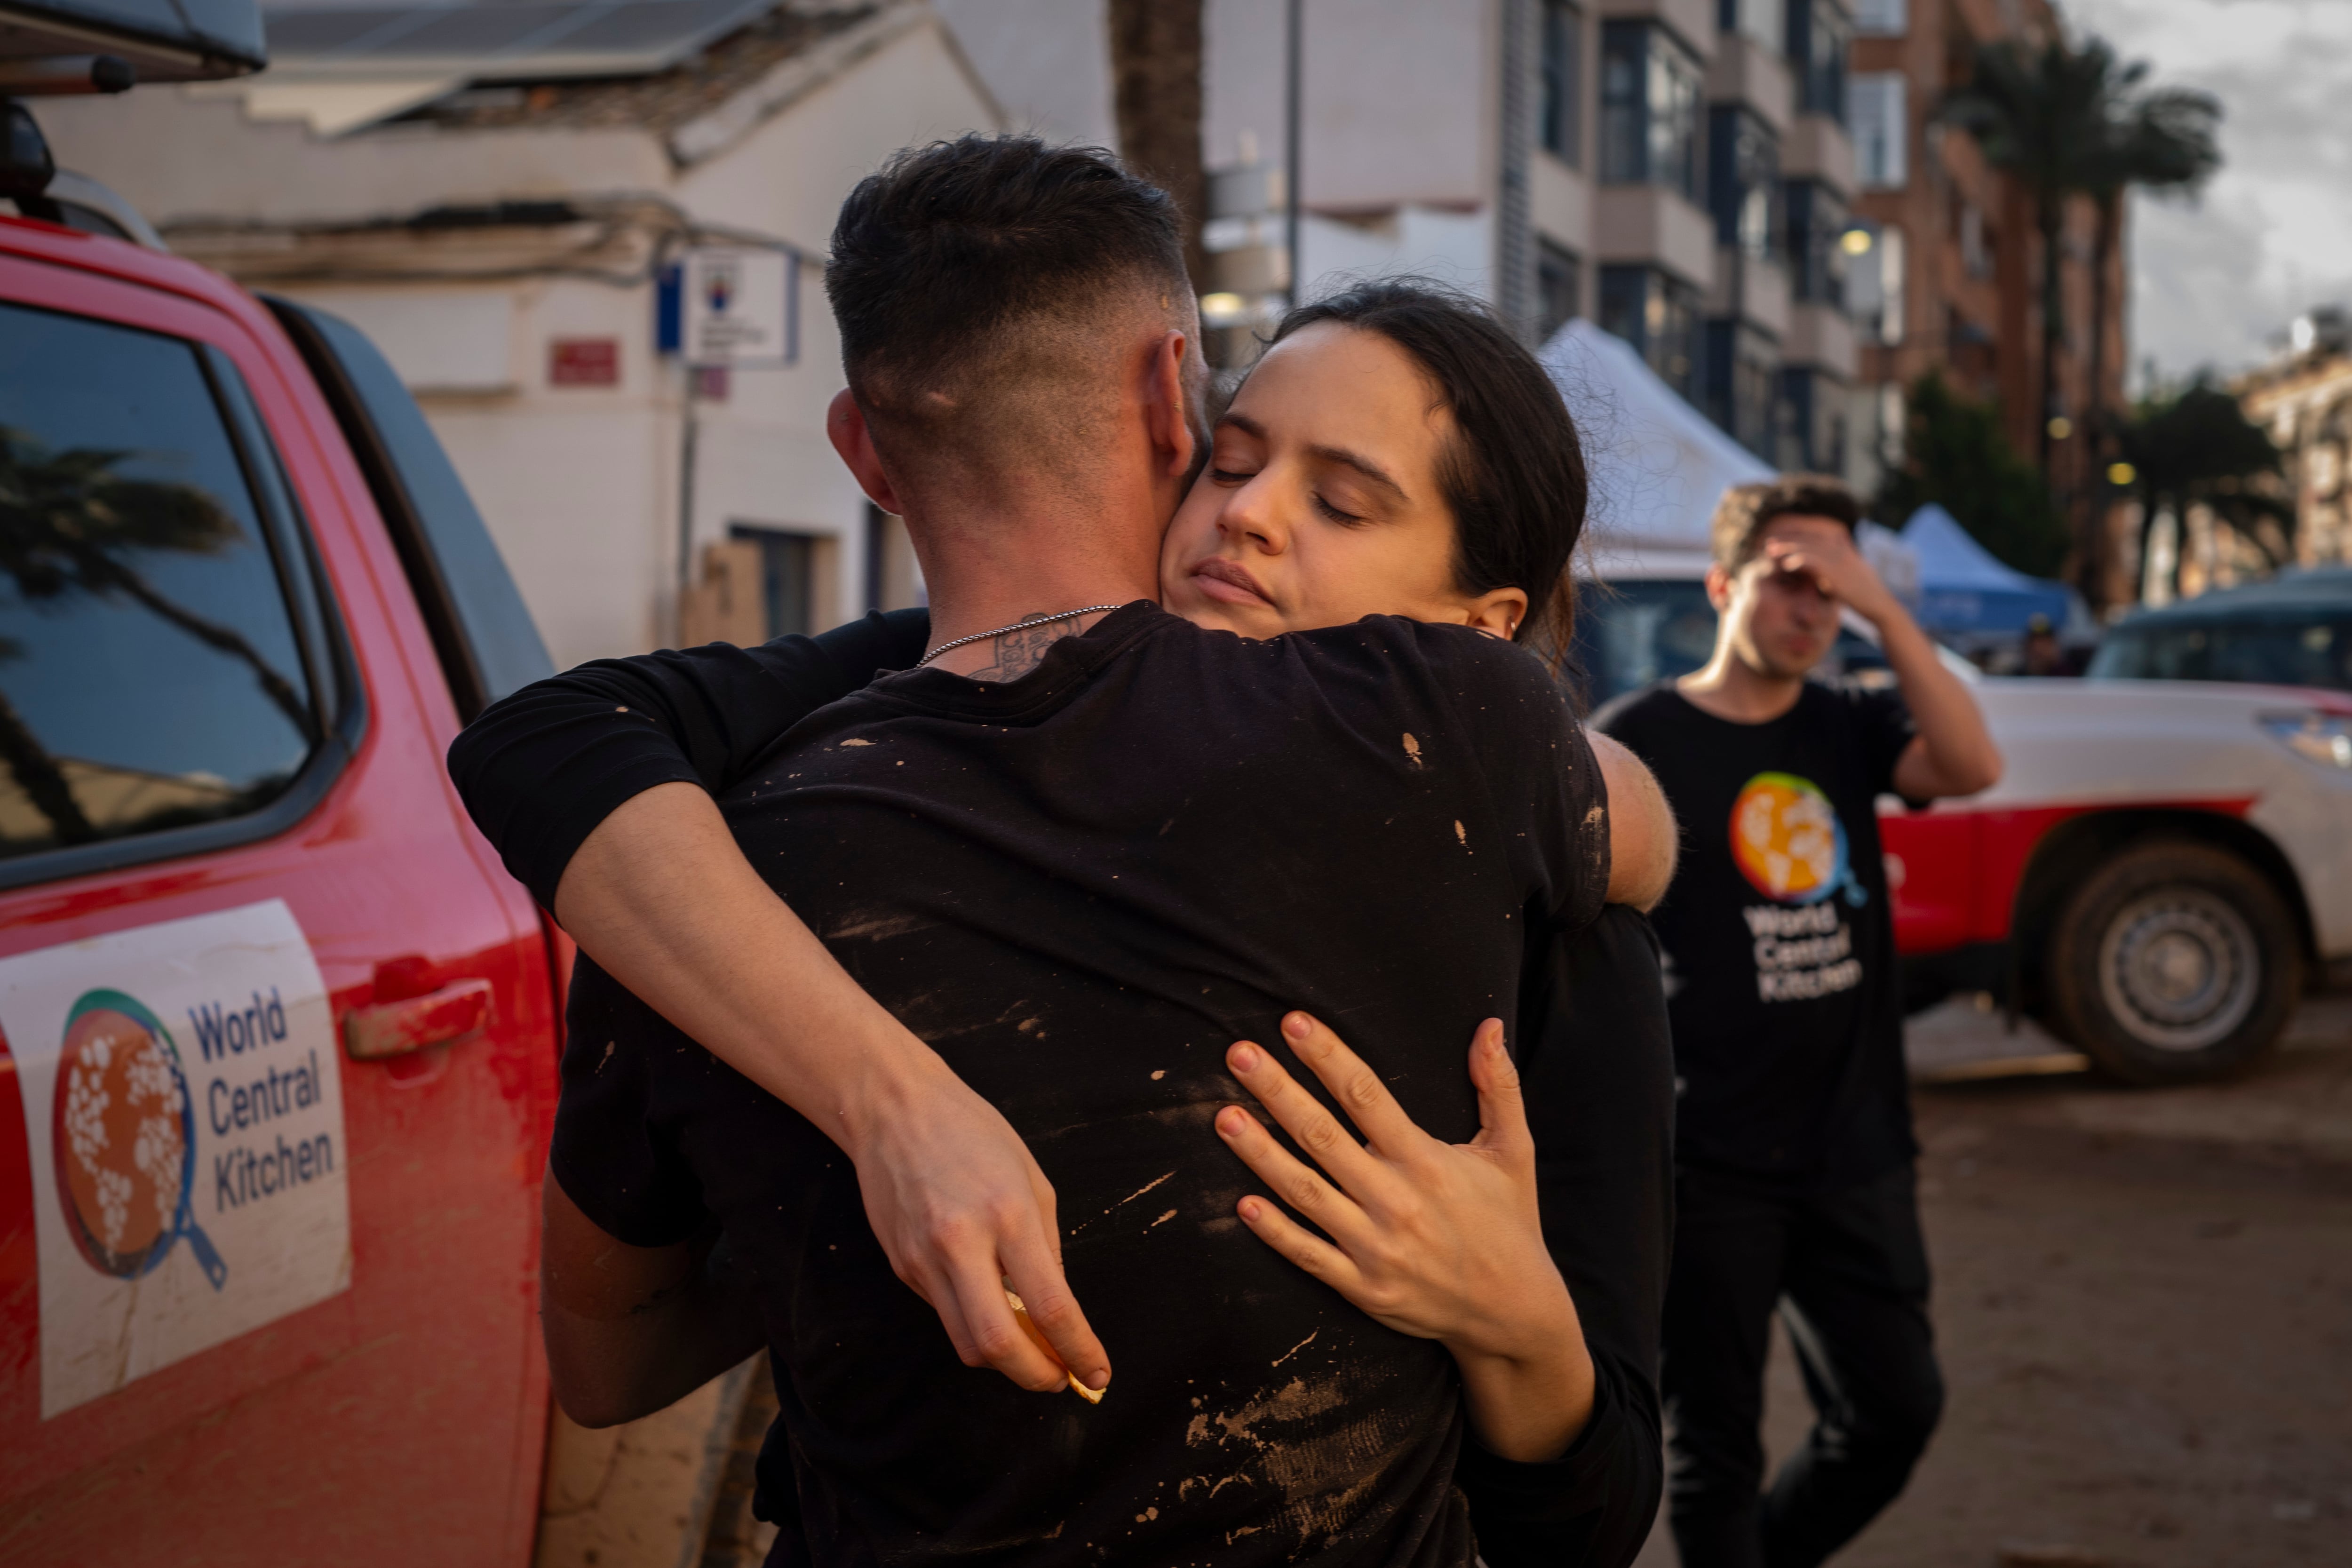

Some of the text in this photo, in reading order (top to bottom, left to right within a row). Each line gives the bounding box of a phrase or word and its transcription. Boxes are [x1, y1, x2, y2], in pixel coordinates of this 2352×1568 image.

[188, 986, 288, 1064] World
[207, 1049, 321, 1138] Central
[214, 1133, 334, 1213] Kitchen
